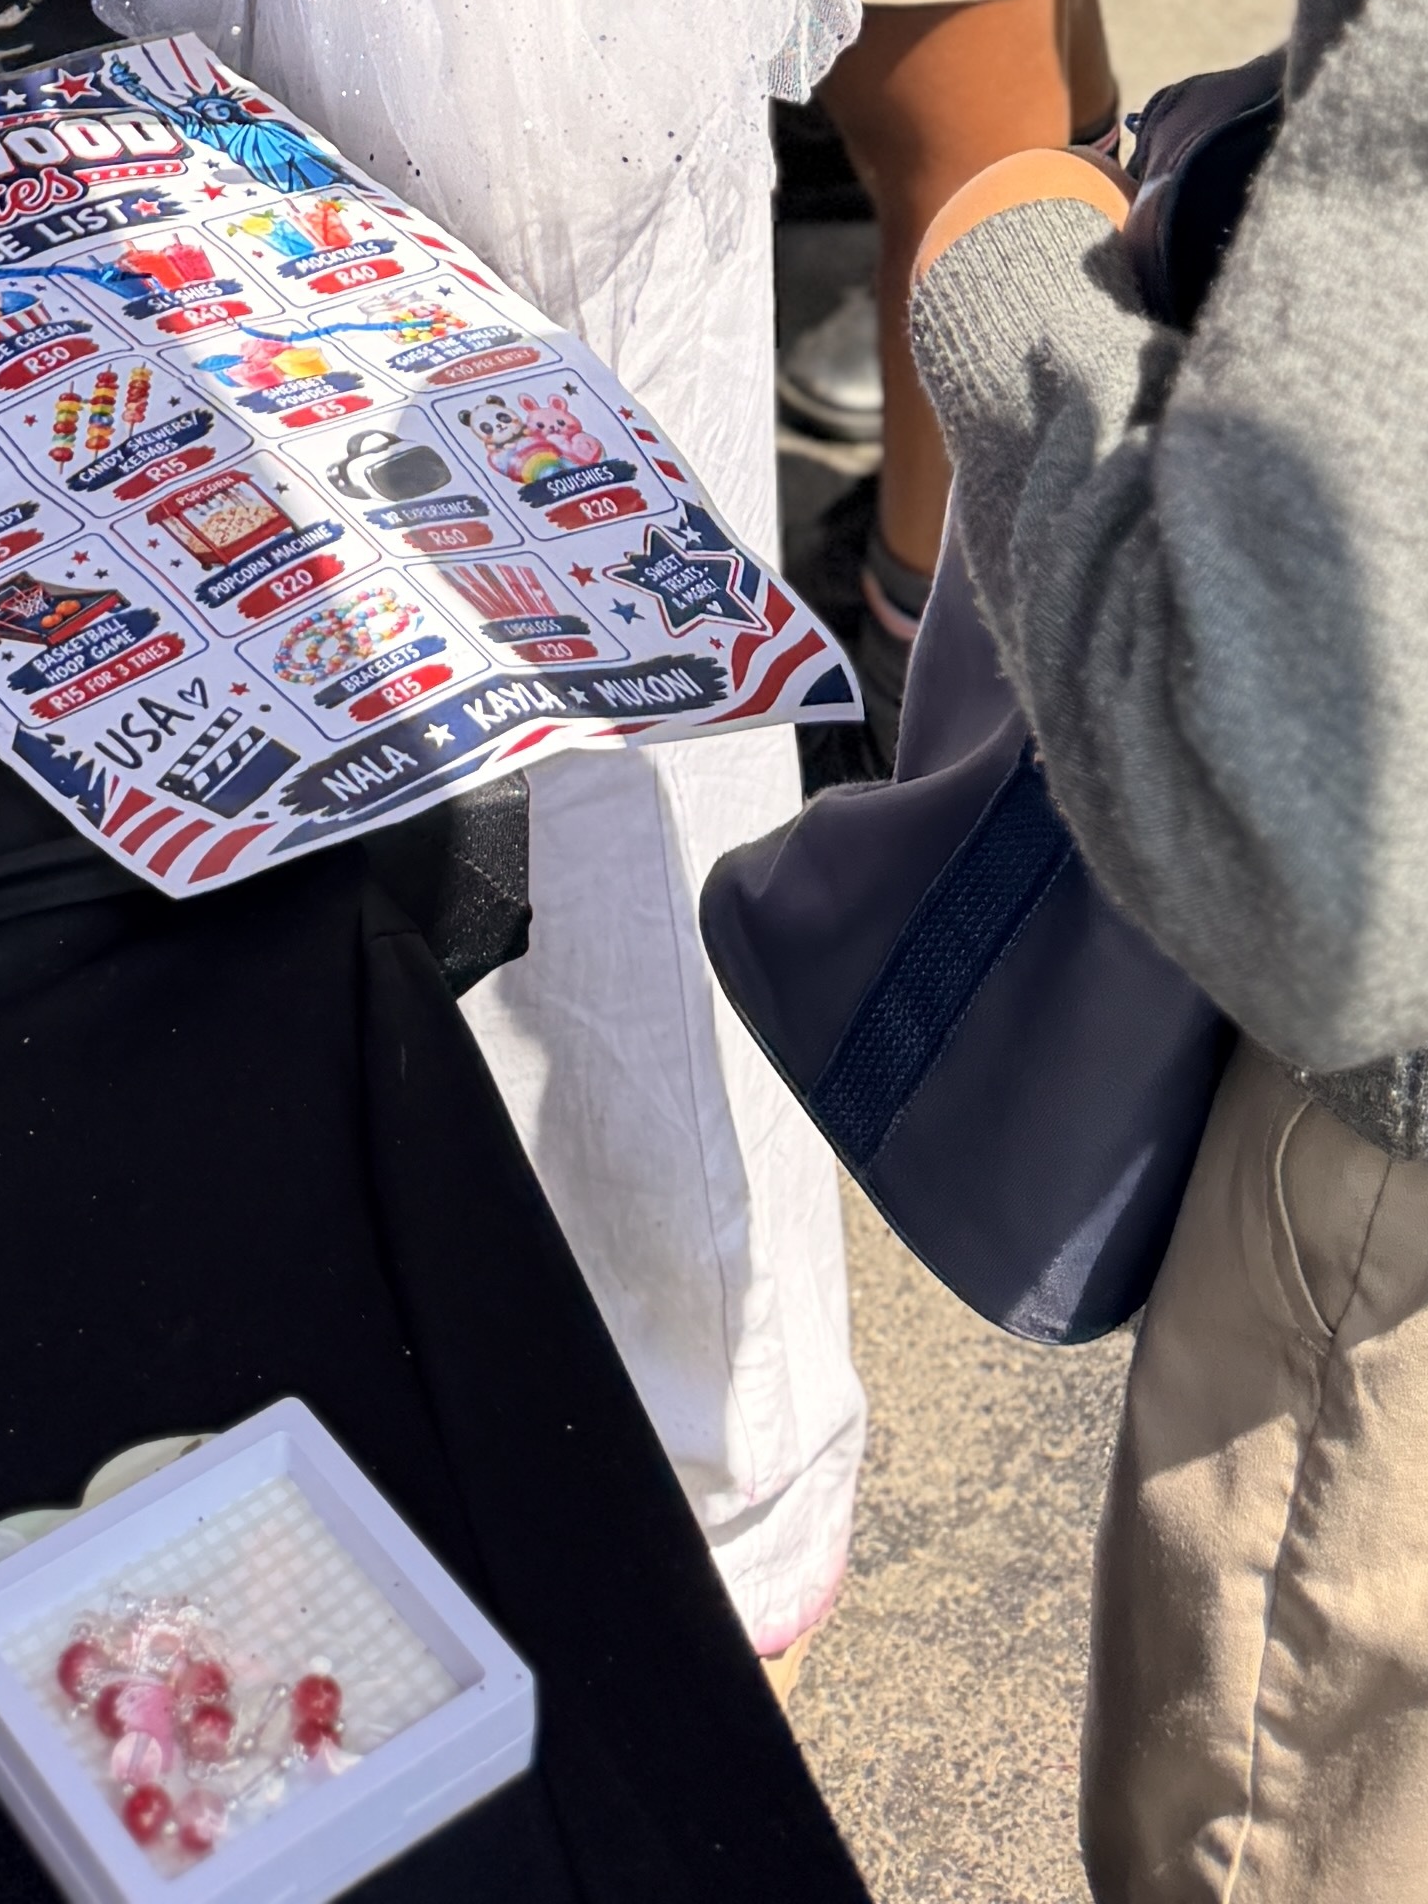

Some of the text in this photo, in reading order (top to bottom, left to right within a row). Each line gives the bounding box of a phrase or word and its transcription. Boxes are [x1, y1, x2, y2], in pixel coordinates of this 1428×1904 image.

[34, 198, 129, 242] LIST
[296, 241, 381, 274] MOCKTAILS
[334, 265, 379, 287] R40
[22, 322, 74, 348] CREAM
[22, 345, 70, 375] R30
[311, 400, 347, 419] R5
[79, 410, 199, 483] CANDY SKEWERS/
[119, 438, 180, 474] KEBABS
[145, 457, 188, 483] R15
[546, 465, 615, 498] SQUISHIES
[579, 496, 618, 520] R20
[428, 528, 468, 547] R60
[207, 523, 334, 601] POPCORN MACHINE
[644, 553, 683, 582] SWEET
[270, 568, 314, 601] R20
[660, 566, 704, 594] TREATS
[32, 616, 127, 673] BASKETBALL
[45, 629, 137, 685] HOOP GAME
[536, 641, 573, 659] R20
[48, 640, 172, 711] R15 FOR 3 TRIES
[341, 643, 421, 693] BRACELETS
[381, 676, 422, 706] R15
[94, 697, 195, 769] USA
[321, 668, 704, 802] NALA KAYLA MUKONI
